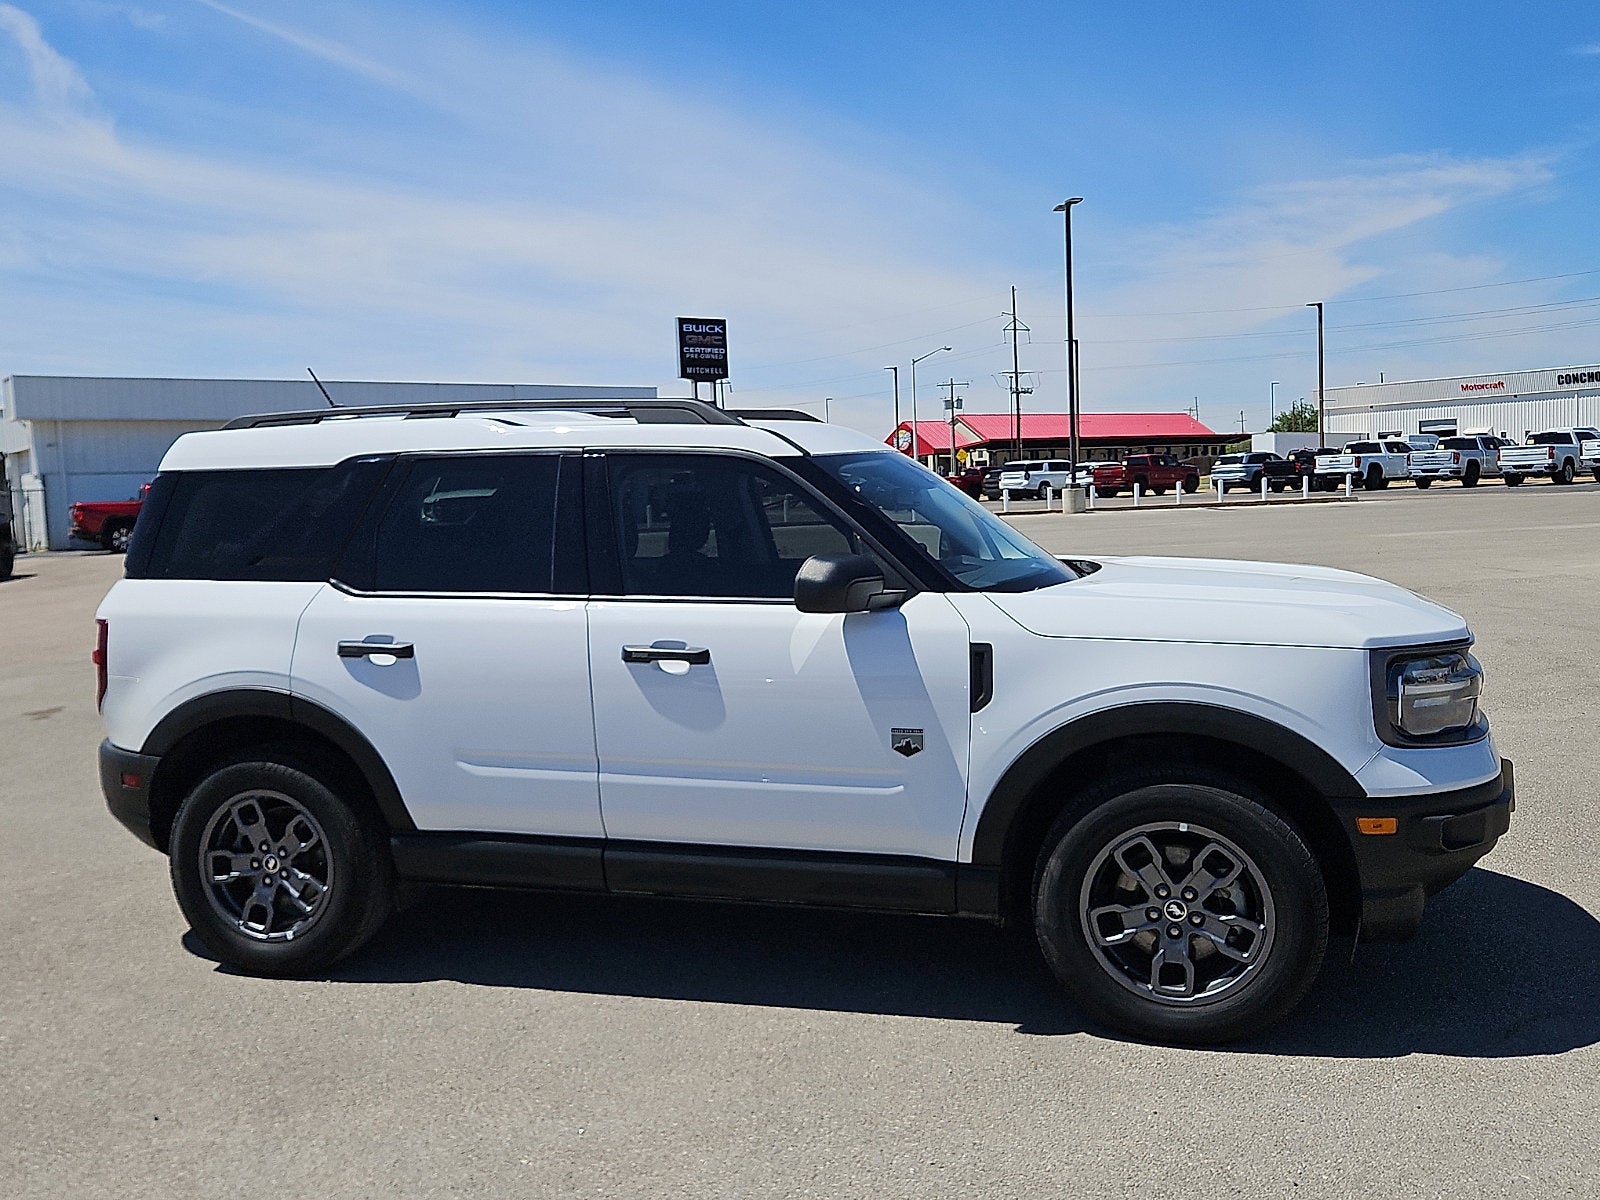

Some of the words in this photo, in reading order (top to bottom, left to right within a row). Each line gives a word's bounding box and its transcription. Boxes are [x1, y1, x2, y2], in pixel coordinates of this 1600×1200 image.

[683, 324, 723, 333] BUICK
[686, 335, 722, 343] GMC
[1557, 371, 1600, 385] CONCHO
[1460, 381, 1504, 391] Motorcraft
